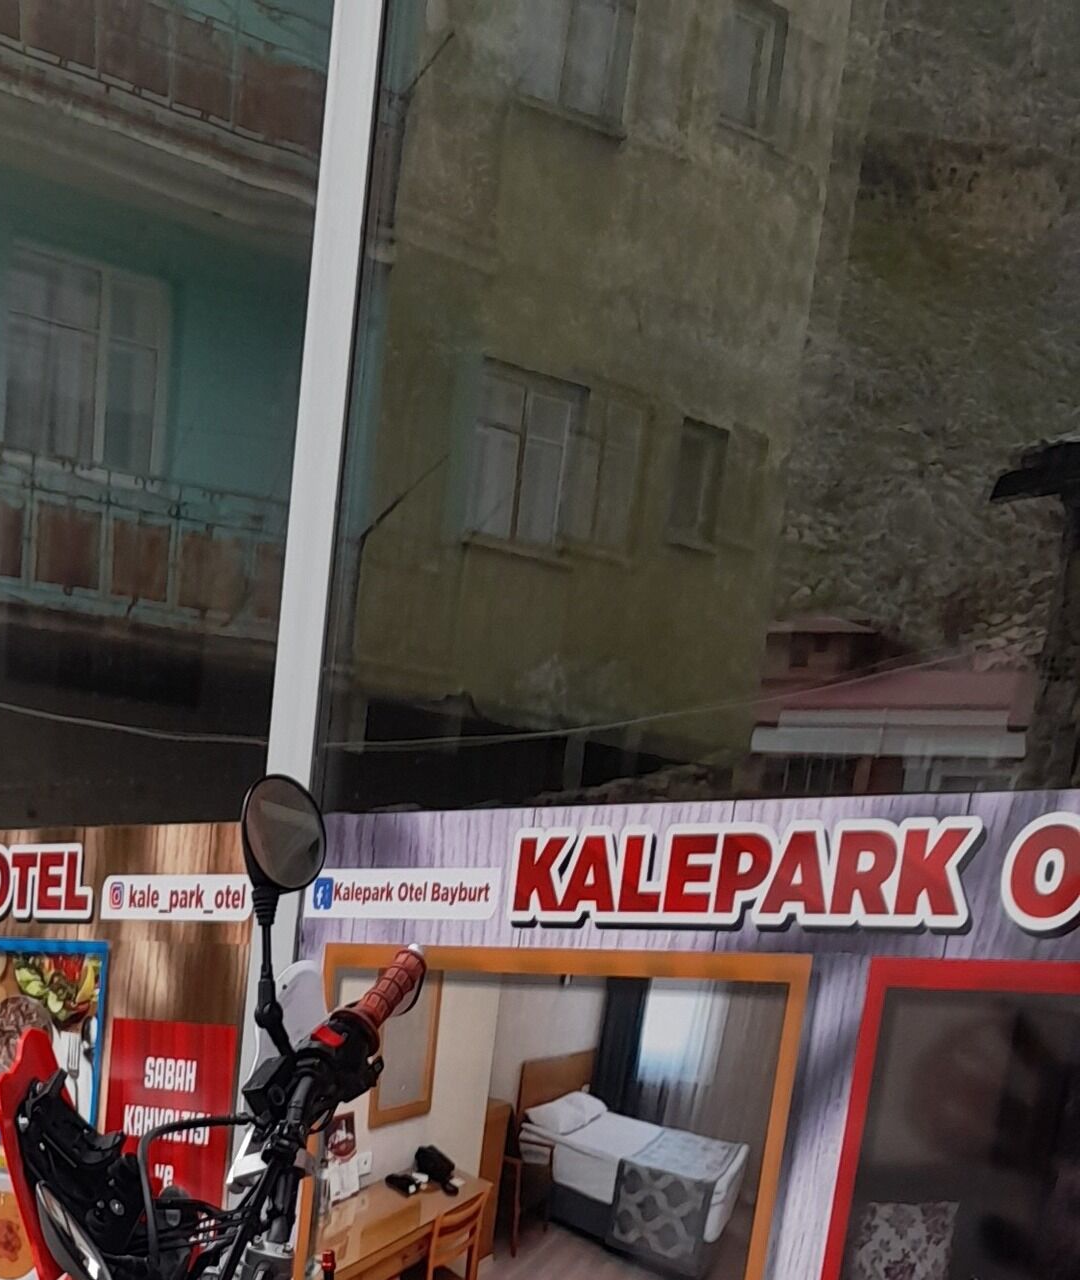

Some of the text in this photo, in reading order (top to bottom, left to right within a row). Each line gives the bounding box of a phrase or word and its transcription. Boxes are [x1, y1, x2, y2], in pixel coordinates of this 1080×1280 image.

[511, 827, 975, 916] KALEPARK
[128, 883, 247, 914] kale_park_otel
[333, 882, 490, 907] Kalepark Otel Bayburt
[143, 1056, 197, 1093] SABAH
